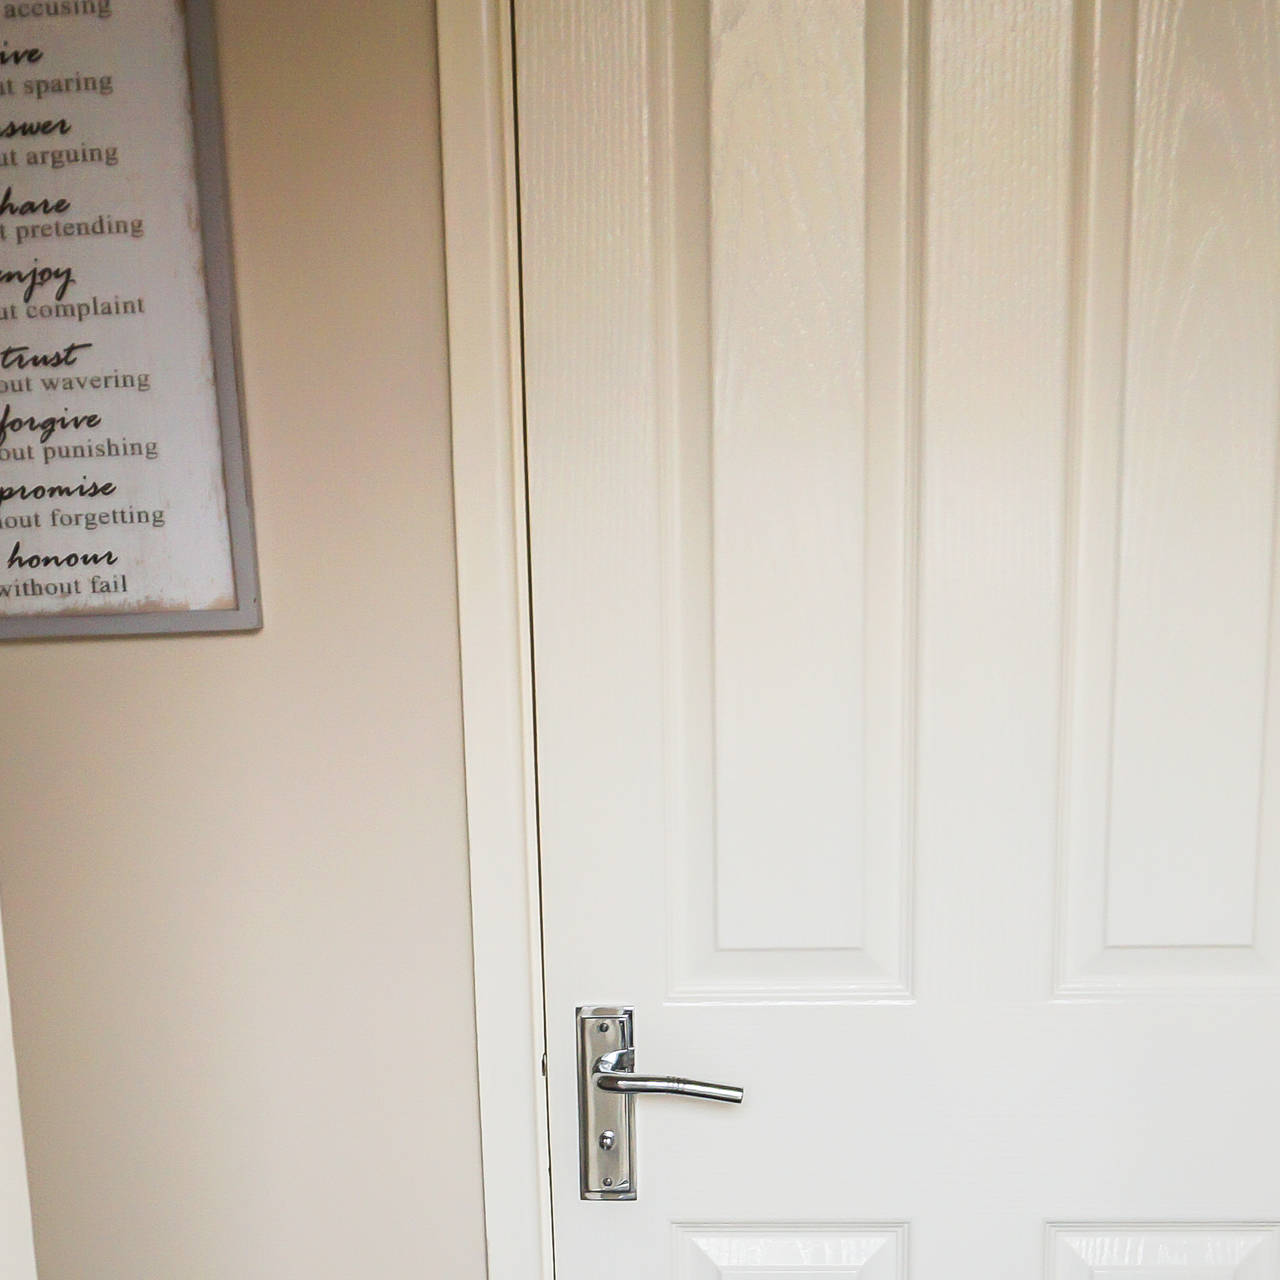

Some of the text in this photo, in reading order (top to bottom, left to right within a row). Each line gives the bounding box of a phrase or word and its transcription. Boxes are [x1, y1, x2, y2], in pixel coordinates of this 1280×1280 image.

[4, 0, 112, 19] accusing
[23, 71, 114, 99] sparing
[26, 143, 119, 170] arguing
[15, 214, 144, 245] pretending
[26, 296, 145, 322] complaint
[0, 342, 93, 370] trust
[40, 369, 151, 392] wavering
[42, 437, 159, 465] punishing
[51, 505, 166, 531] forgetting
[7, 541, 118, 569] honour
[91, 574, 128, 594] fail
